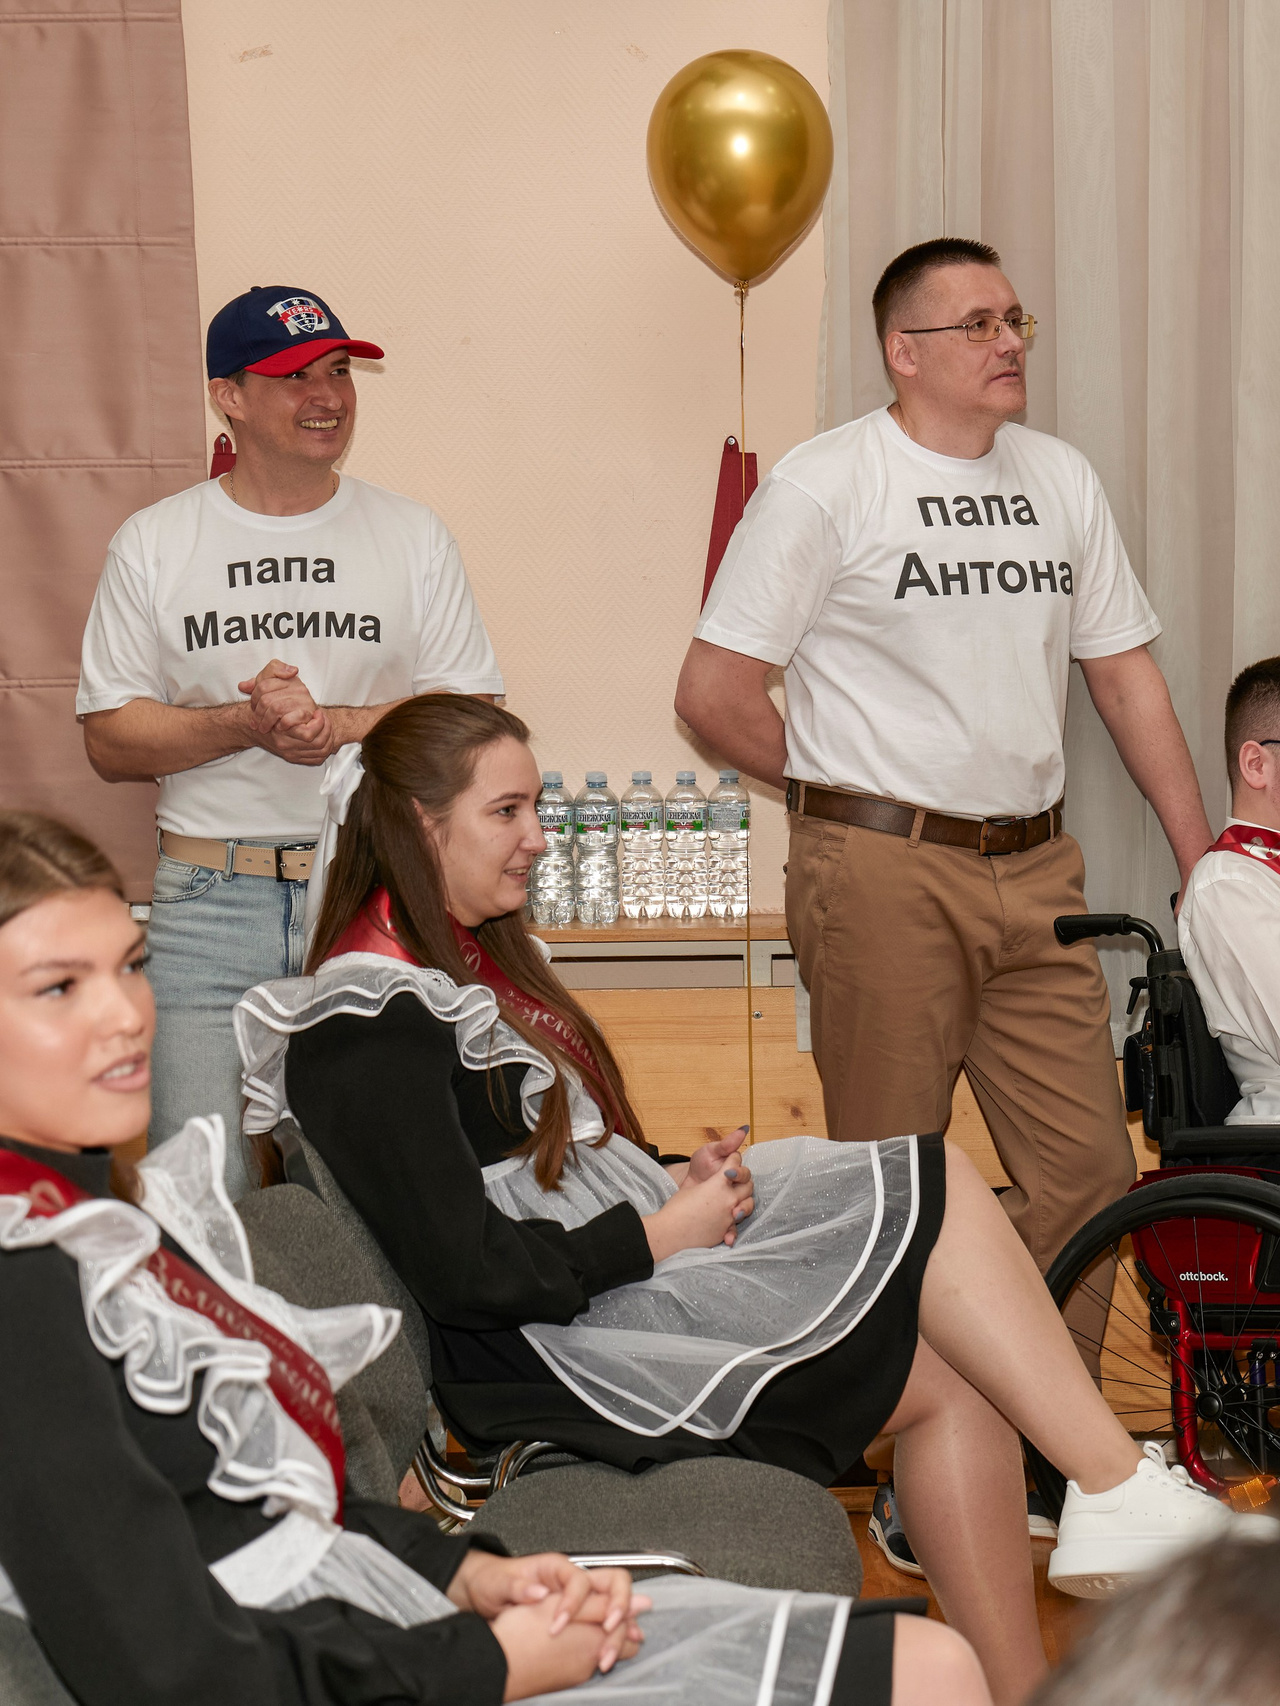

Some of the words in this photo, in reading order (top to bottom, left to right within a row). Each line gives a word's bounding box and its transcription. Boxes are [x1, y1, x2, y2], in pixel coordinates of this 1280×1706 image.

[916, 494, 1040, 527] папа
[227, 556, 336, 589] папа
[894, 552, 1074, 599] Антона
[183, 610, 382, 652] Максима
[576, 813, 611, 822] СЕНЕЖСКАЯ
[666, 811, 702, 820] СЕНЕЖСКАЯ
